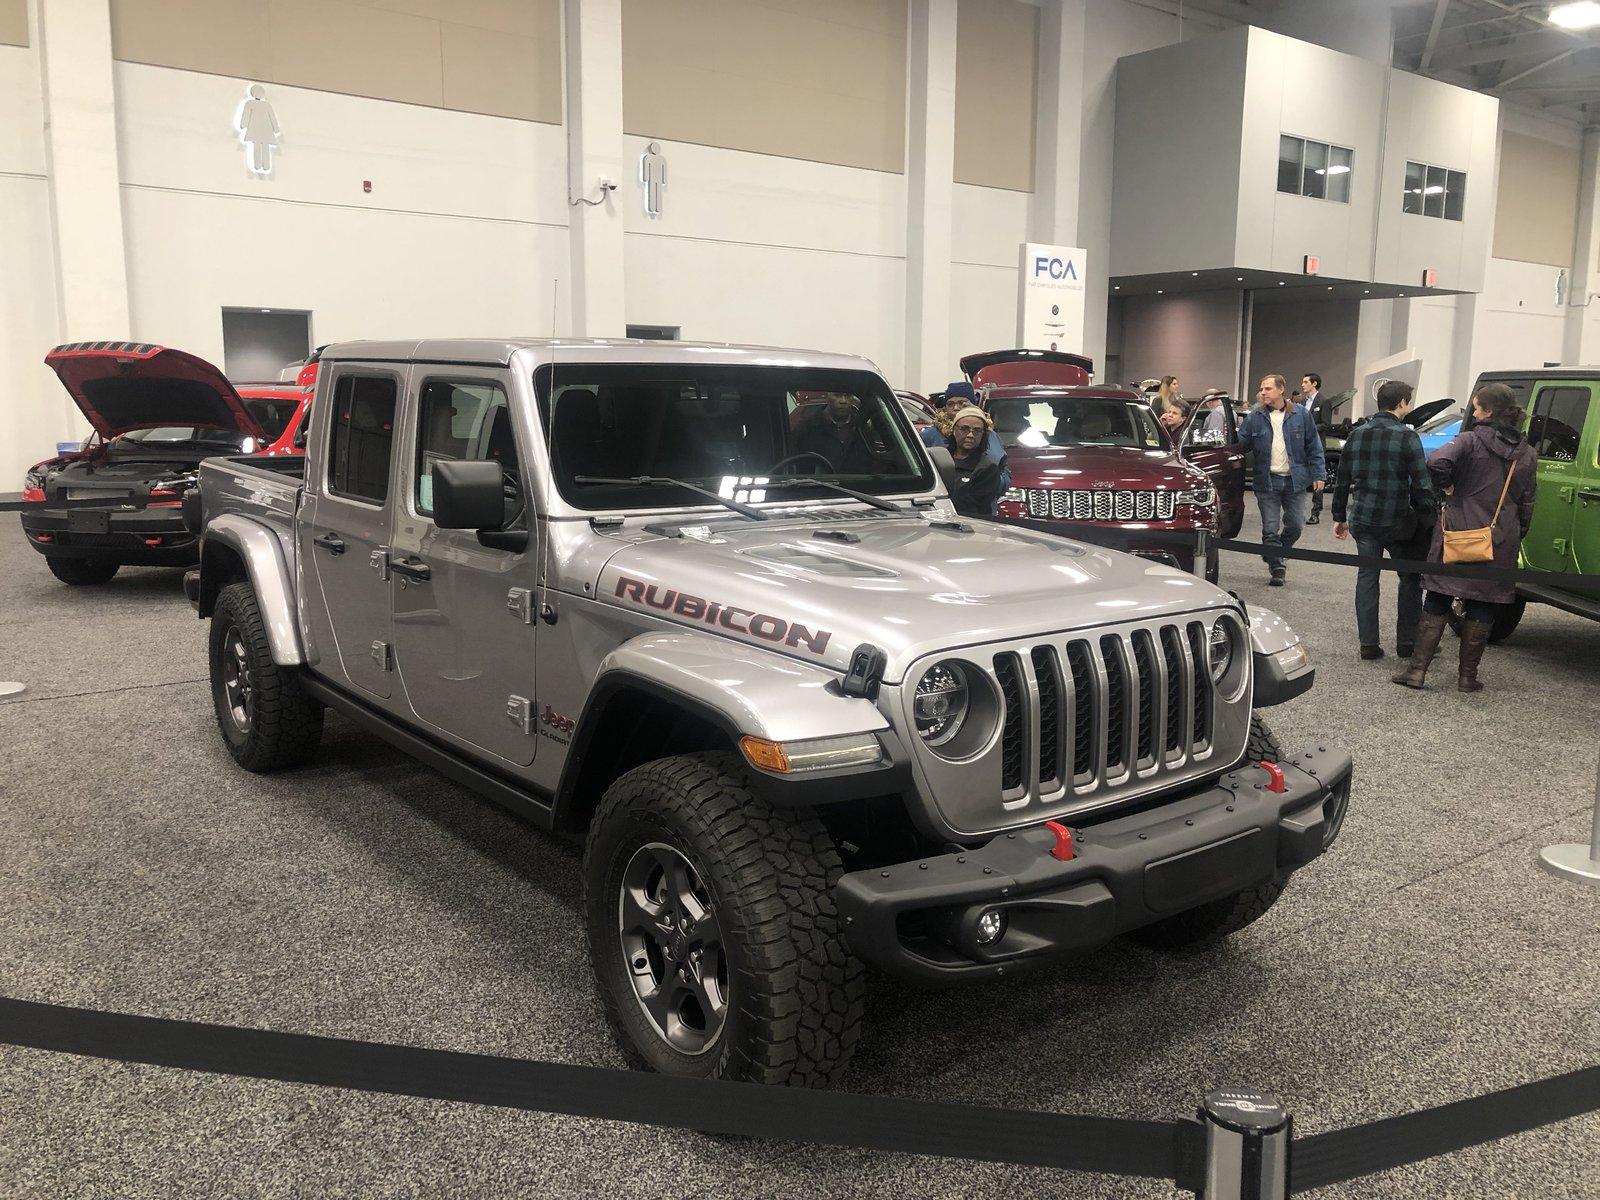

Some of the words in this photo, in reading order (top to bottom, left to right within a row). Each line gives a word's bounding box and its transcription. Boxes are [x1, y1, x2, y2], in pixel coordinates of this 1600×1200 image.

[1036, 257, 1077, 280] FCA
[614, 576, 833, 656] RUBICON
[541, 704, 575, 737] Jeep
